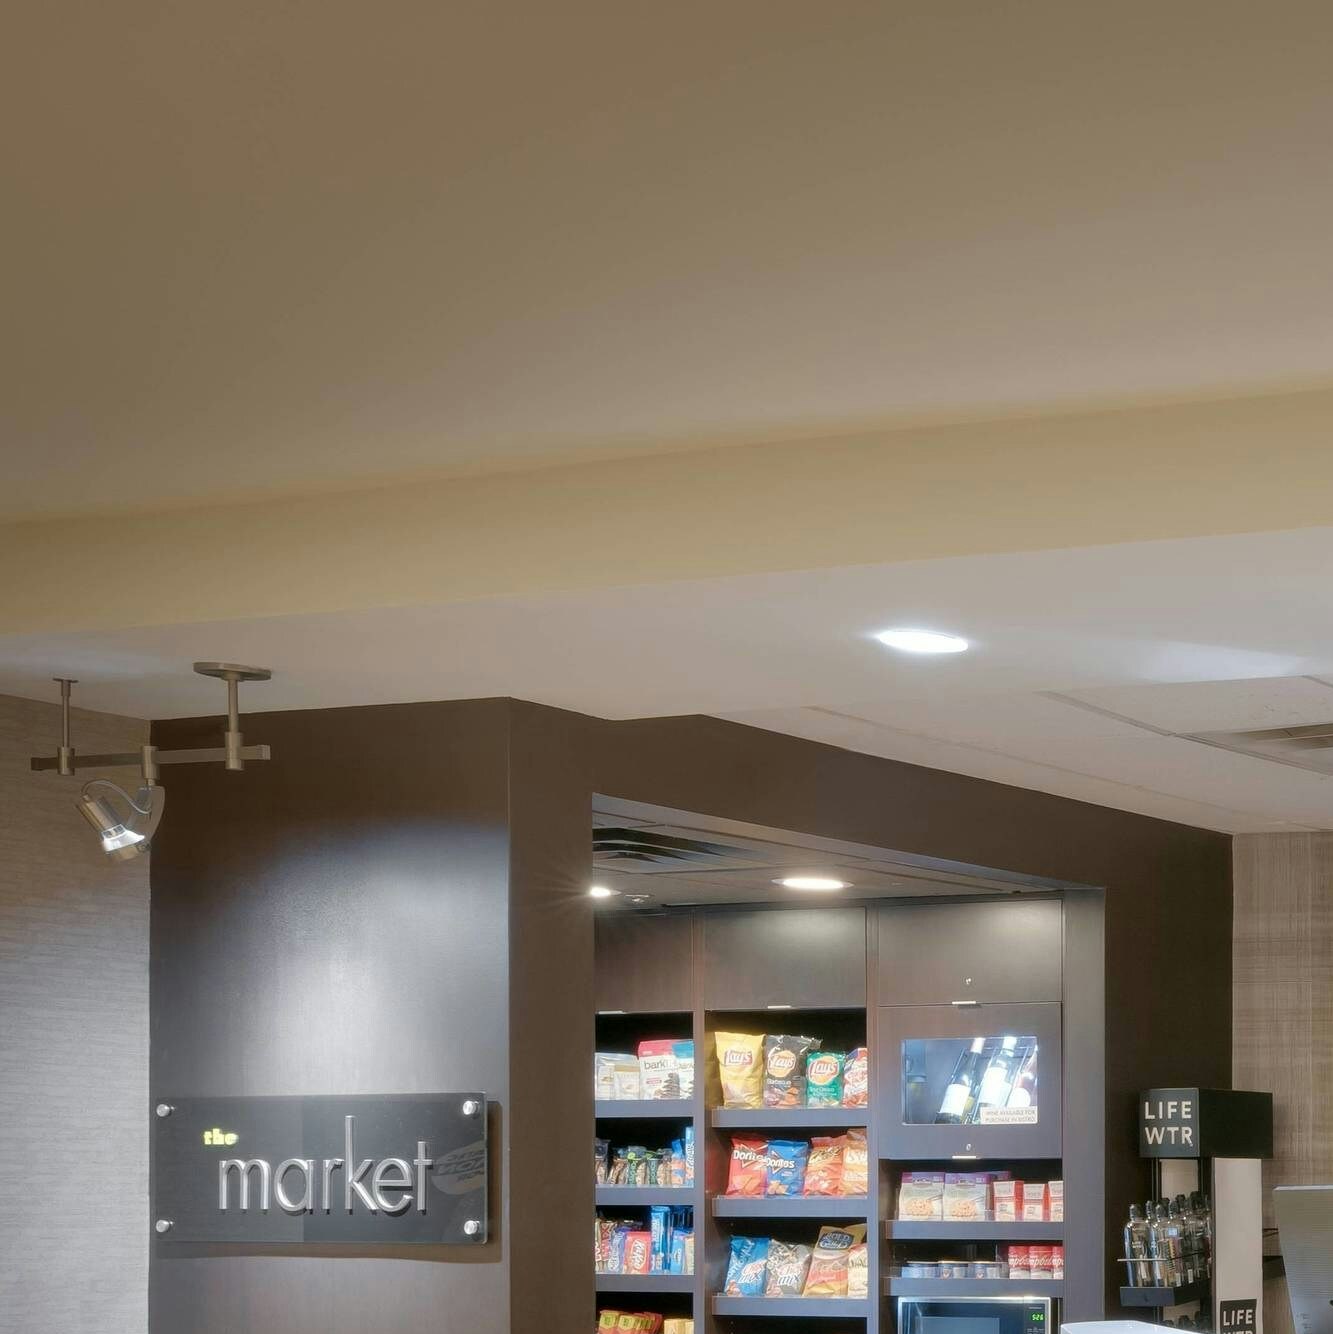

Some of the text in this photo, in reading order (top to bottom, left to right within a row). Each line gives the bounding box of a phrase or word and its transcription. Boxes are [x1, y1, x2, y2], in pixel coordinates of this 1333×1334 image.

[1145, 1101, 1192, 1119] LIFE
[203, 1128, 239, 1145] the
[1145, 1127, 1193, 1144] WTR
[219, 1115, 434, 1212] market
[1223, 1309, 1253, 1326] LIFE
